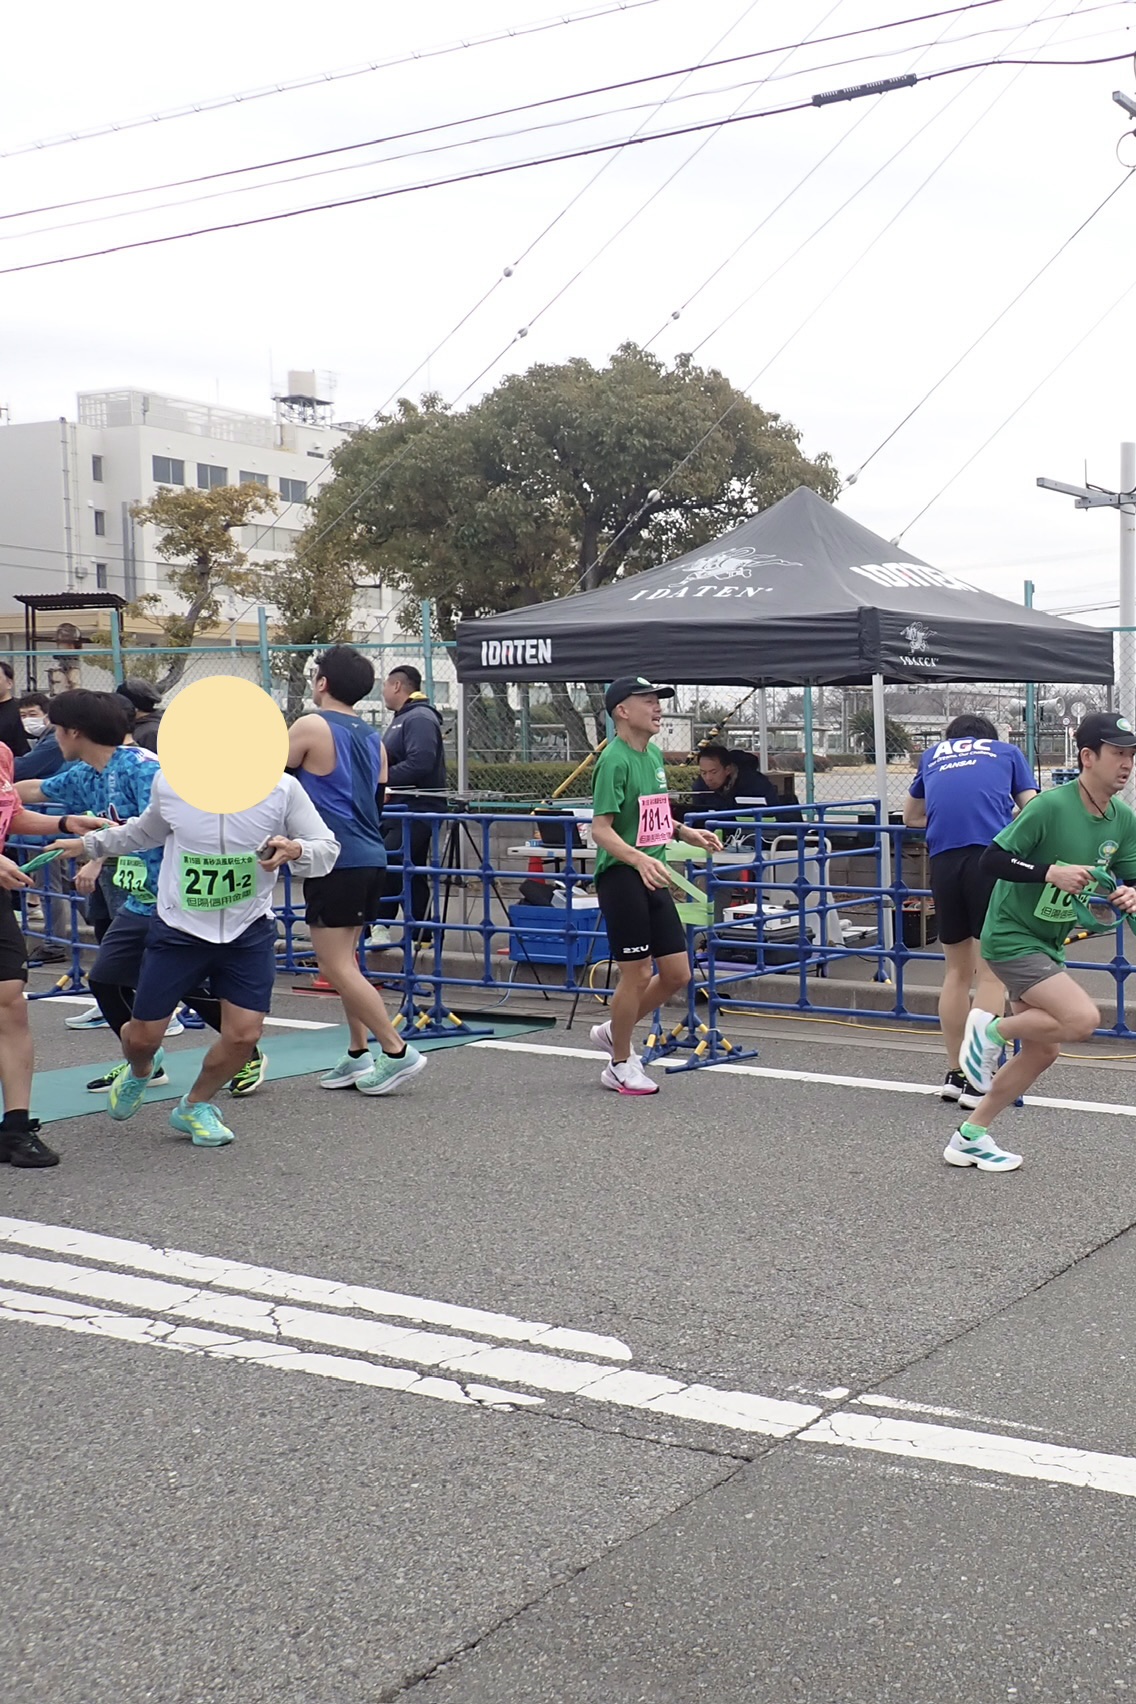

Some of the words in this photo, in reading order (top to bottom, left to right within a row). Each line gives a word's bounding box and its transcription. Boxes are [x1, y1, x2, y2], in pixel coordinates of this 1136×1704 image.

[628, 585, 764, 601] IDATEN
[481, 638, 552, 667] IDATEN
[933, 739, 993, 759] AGC
[939, 759, 977, 772] KANSAI
[642, 807, 671, 833] 181-1
[185, 868, 252, 896] 271-2
[623, 944, 649, 954] 2XU
